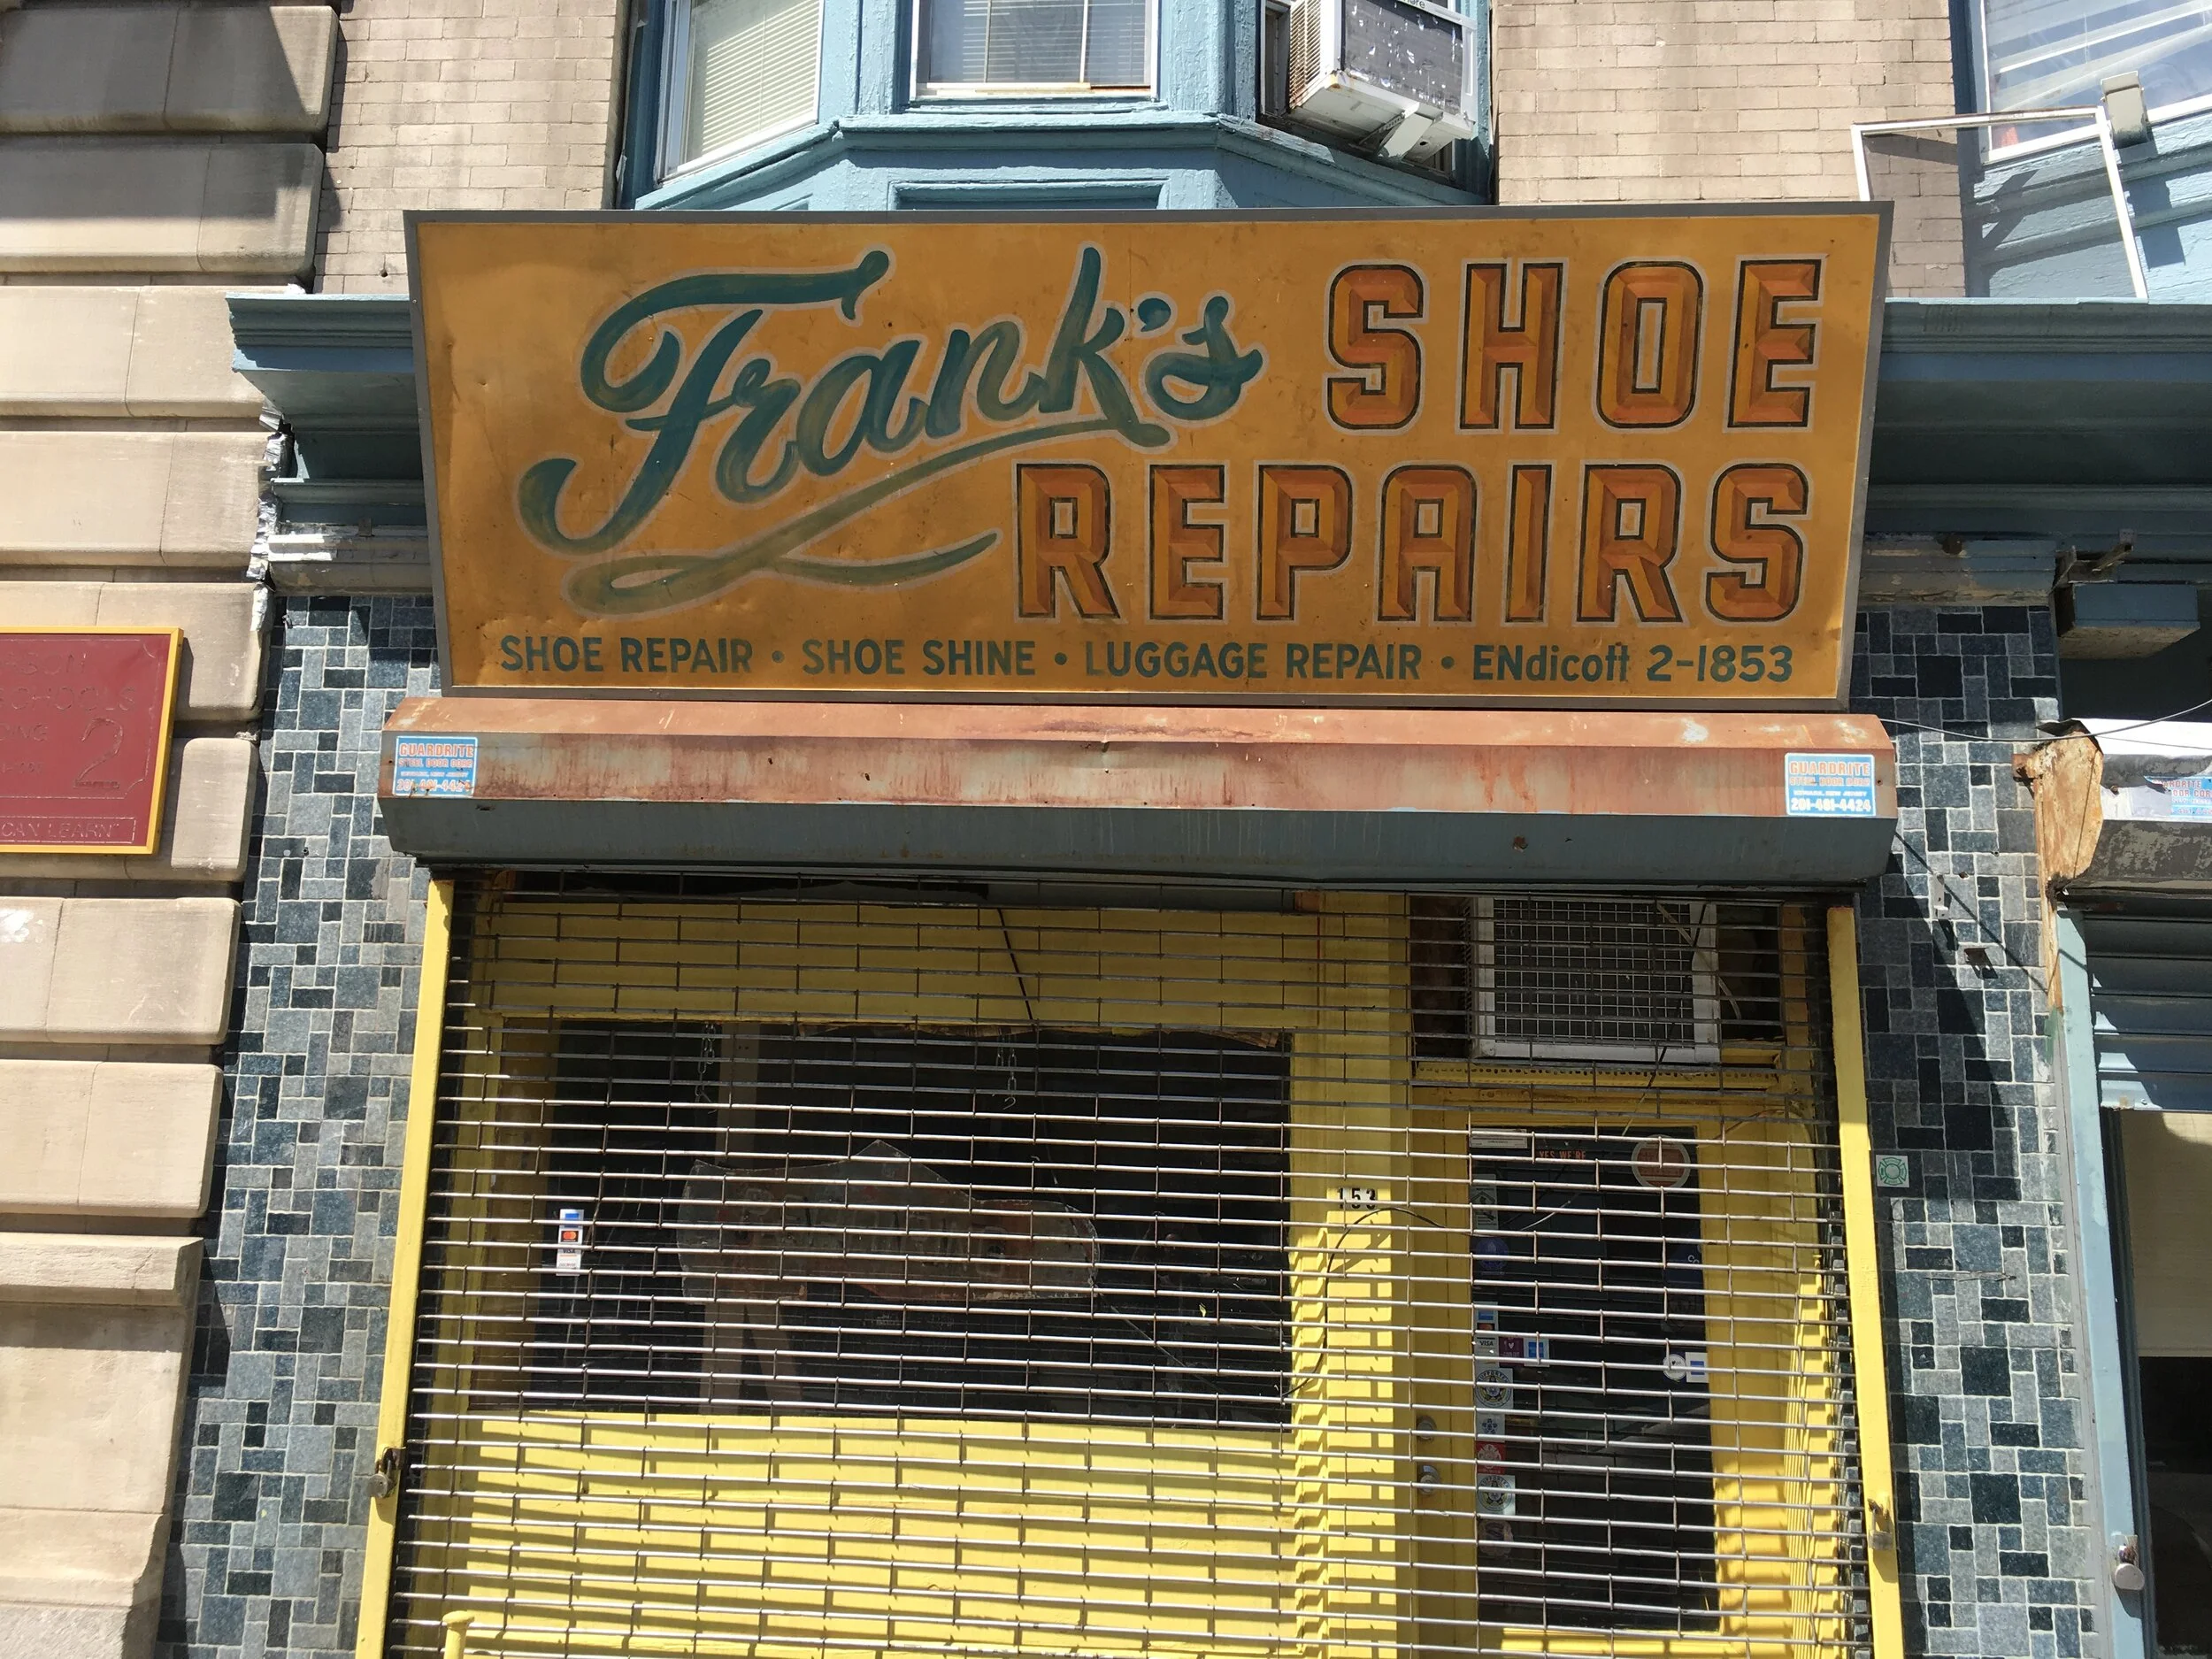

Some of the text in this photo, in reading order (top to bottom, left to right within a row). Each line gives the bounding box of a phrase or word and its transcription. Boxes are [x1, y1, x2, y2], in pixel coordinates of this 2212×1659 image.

[1326, 259, 1824, 432] SHOE
[518, 246, 1263, 609] Frank's
[1018, 463, 1809, 623] REPAIRS
[501, 635, 1793, 683] SHOE REPAIR SHOE SHINE LUGGAGE REPAIR ENdicott 2-1853
[73, 718, 123, 788] 2
[399, 743, 474, 758] GUARDRITE
[1789, 761, 1870, 776] GUARDRITE
[2193, 790, 2212, 799] COR
[1337, 1187, 1376, 1210] 153
